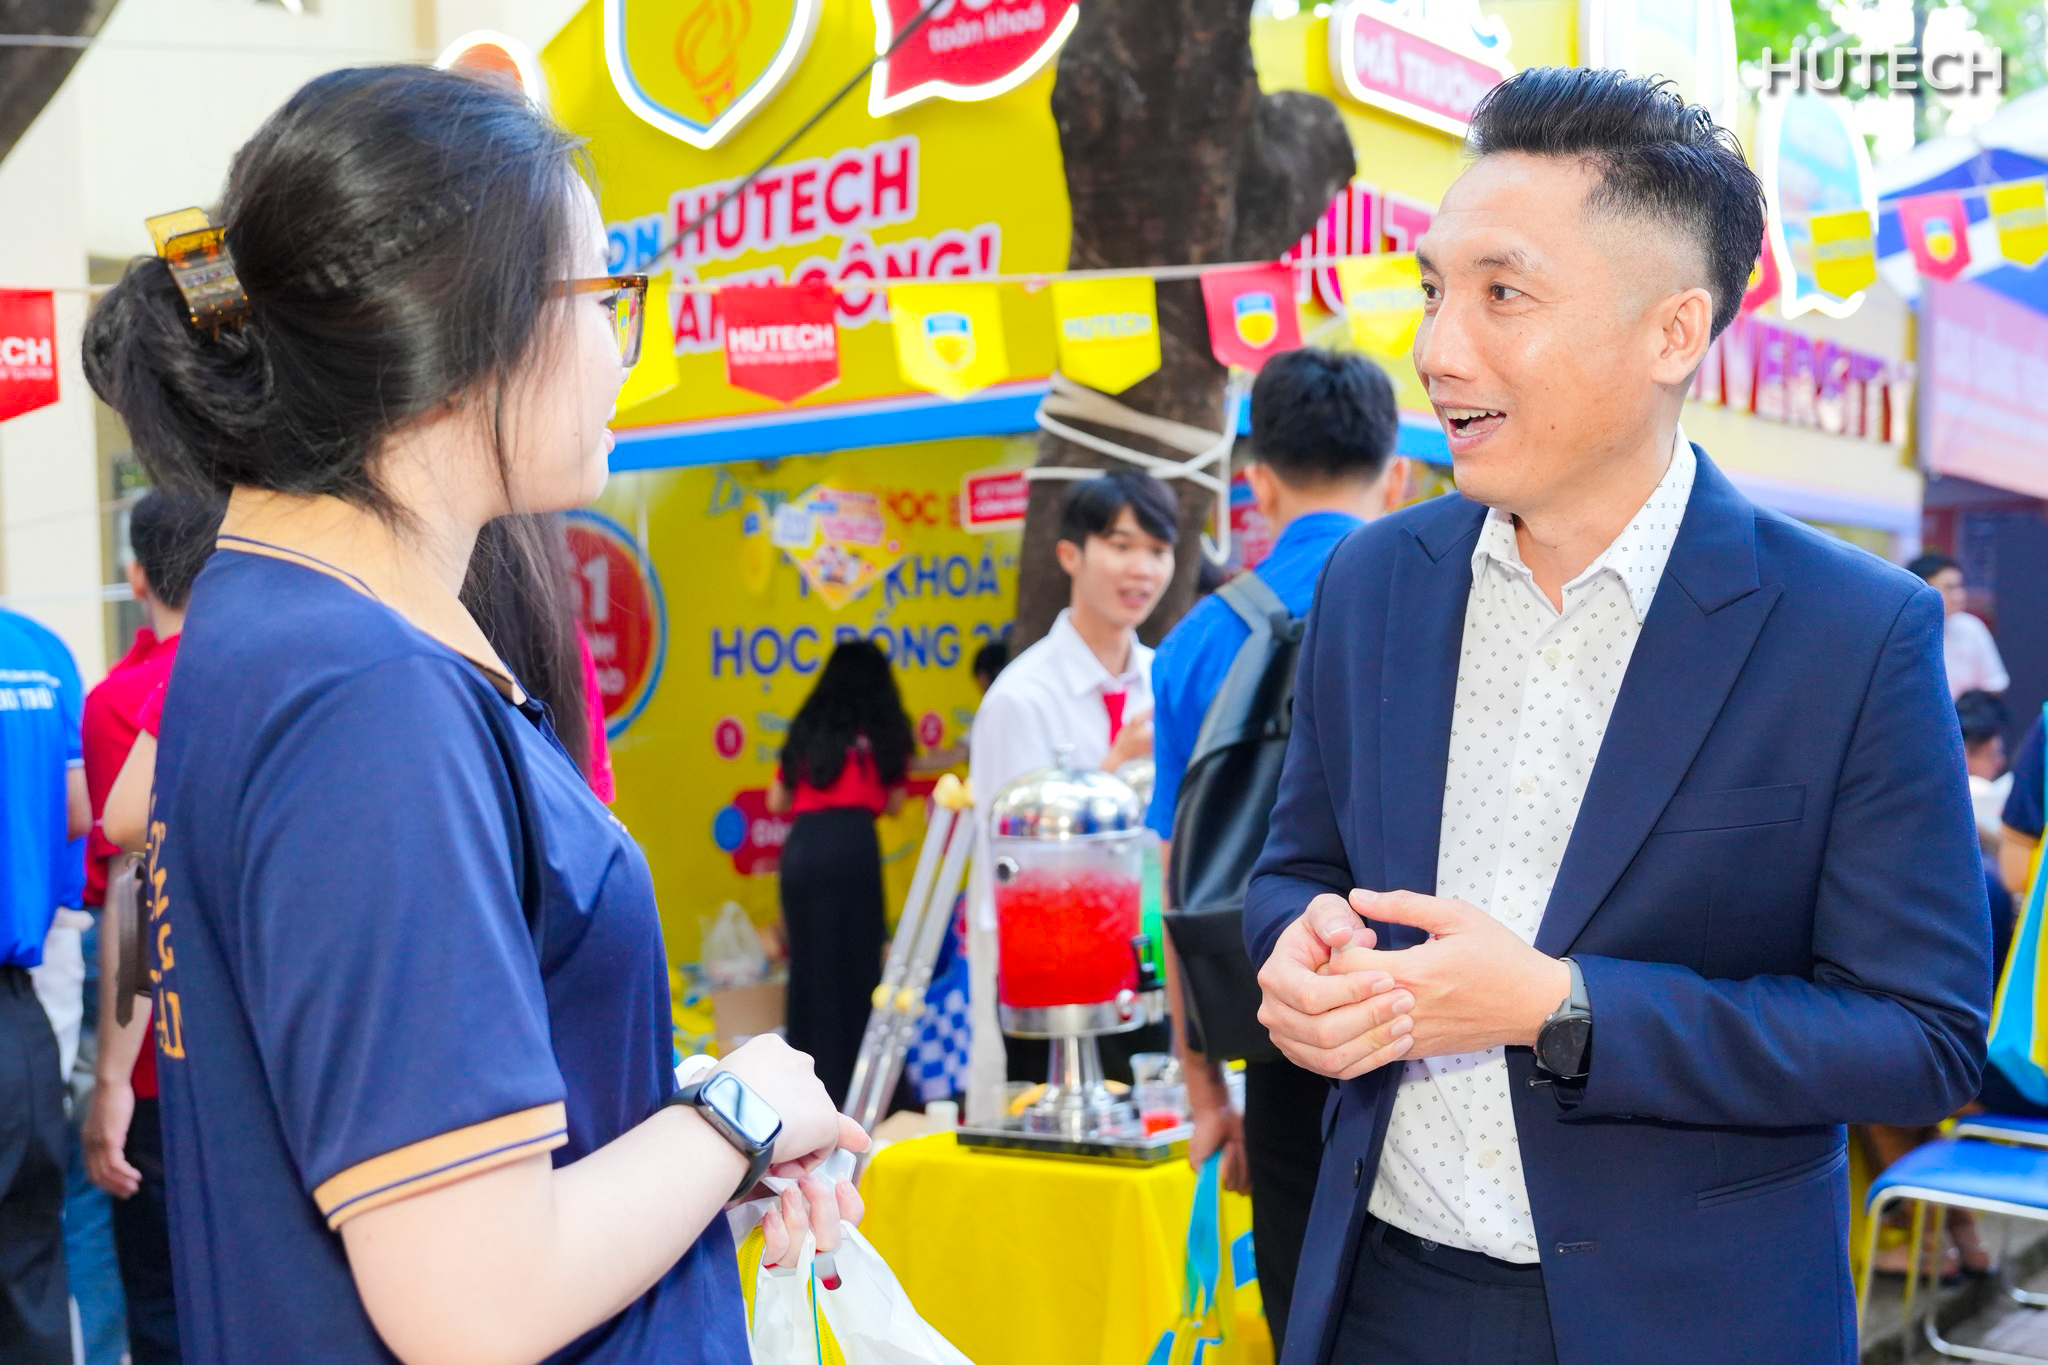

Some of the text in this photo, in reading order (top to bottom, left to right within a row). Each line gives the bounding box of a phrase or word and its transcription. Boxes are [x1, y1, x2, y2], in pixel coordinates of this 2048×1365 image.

[674, 146, 911, 260] HUTECH
[728, 324, 834, 353] HUTECH
[712, 627, 821, 693] HỌC
